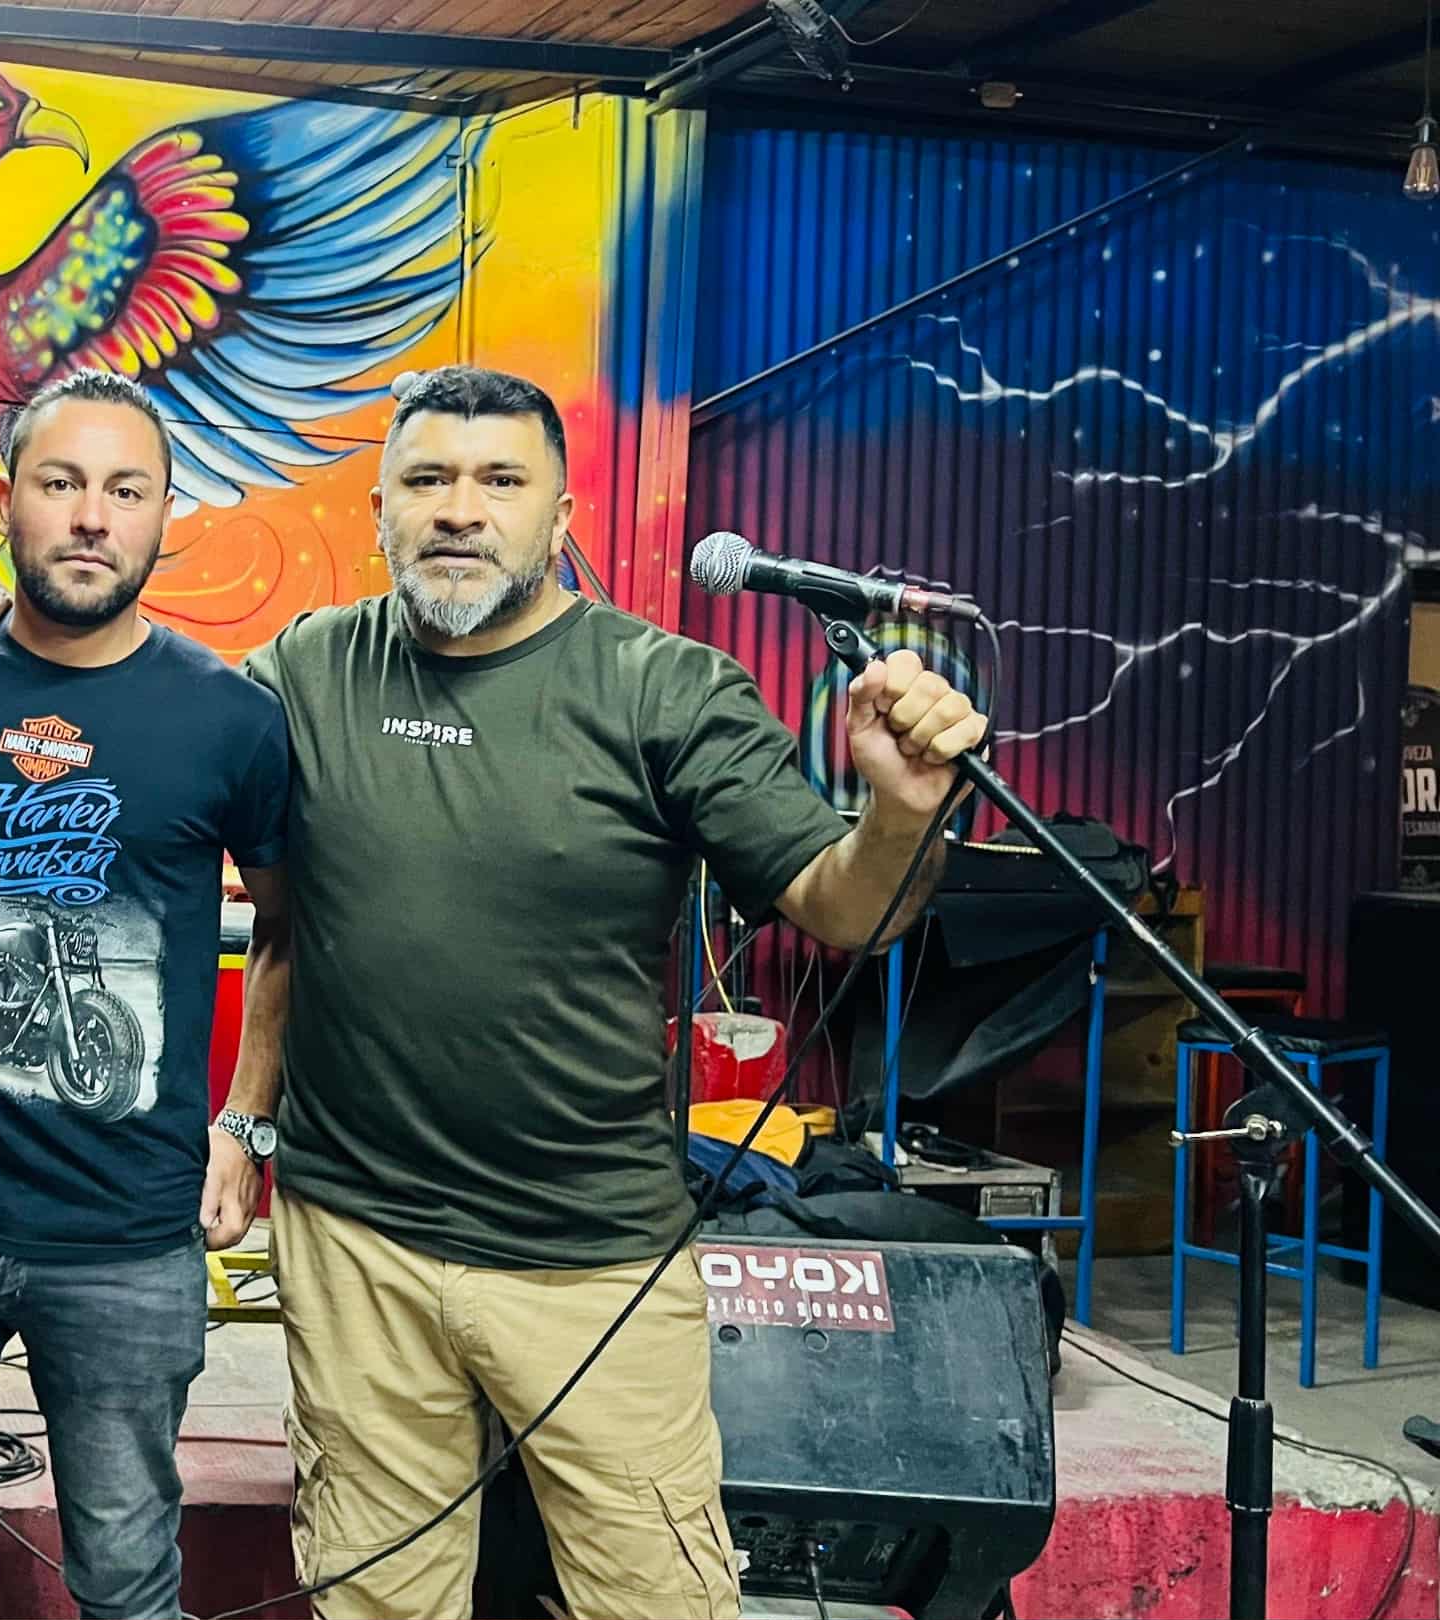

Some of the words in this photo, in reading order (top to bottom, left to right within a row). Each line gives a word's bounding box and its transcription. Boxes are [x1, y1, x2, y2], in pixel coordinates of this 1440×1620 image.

[27, 721, 73, 741] MOTOR
[381, 717, 473, 746] INSPIRE
[3, 733, 89, 764] HARLEY-DAVIDSON
[19, 756, 65, 779] COMPANY
[700, 1252, 881, 1296] OYOK
